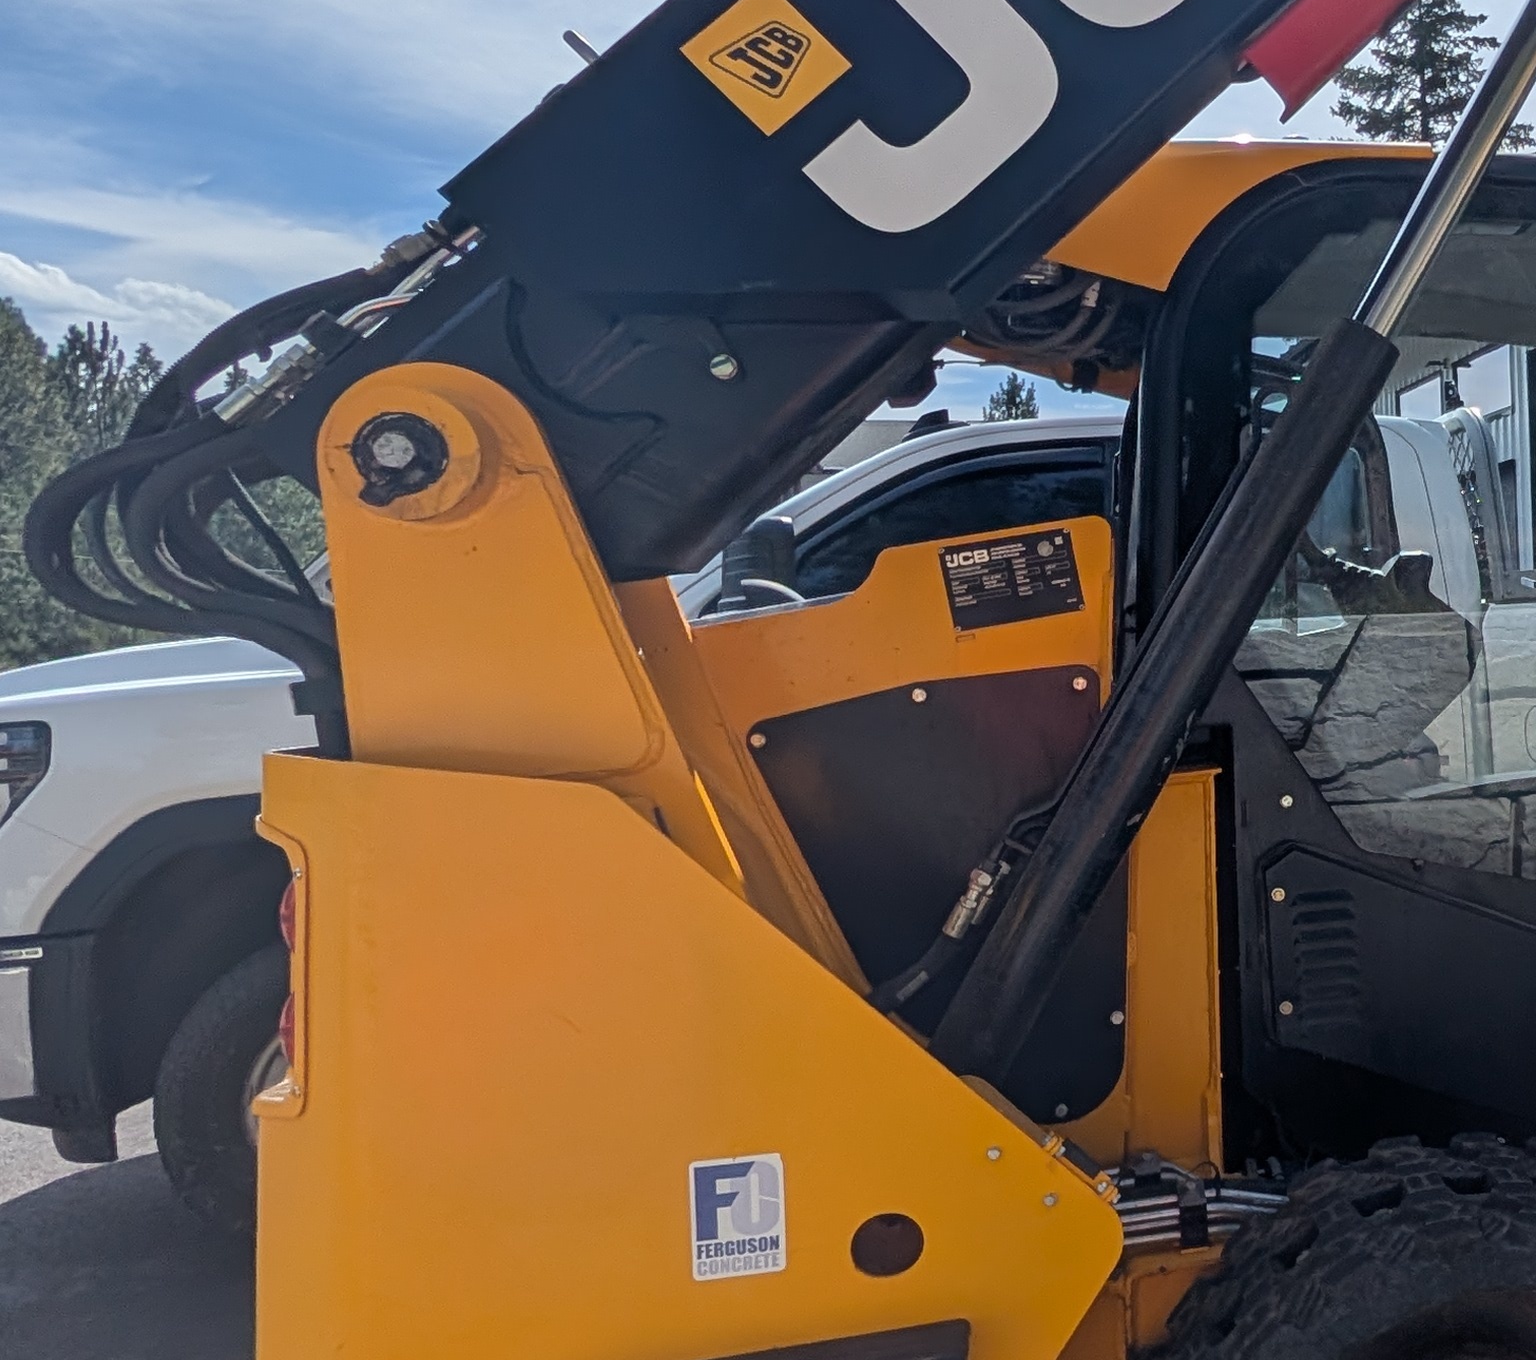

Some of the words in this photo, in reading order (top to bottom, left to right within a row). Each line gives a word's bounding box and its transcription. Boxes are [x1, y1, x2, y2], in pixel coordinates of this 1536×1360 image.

[726, 26, 804, 89] JCB
[946, 549, 990, 568] JCB
[696, 1235, 780, 1260] FERGUSON
[696, 1252, 780, 1276] CONCRETE
